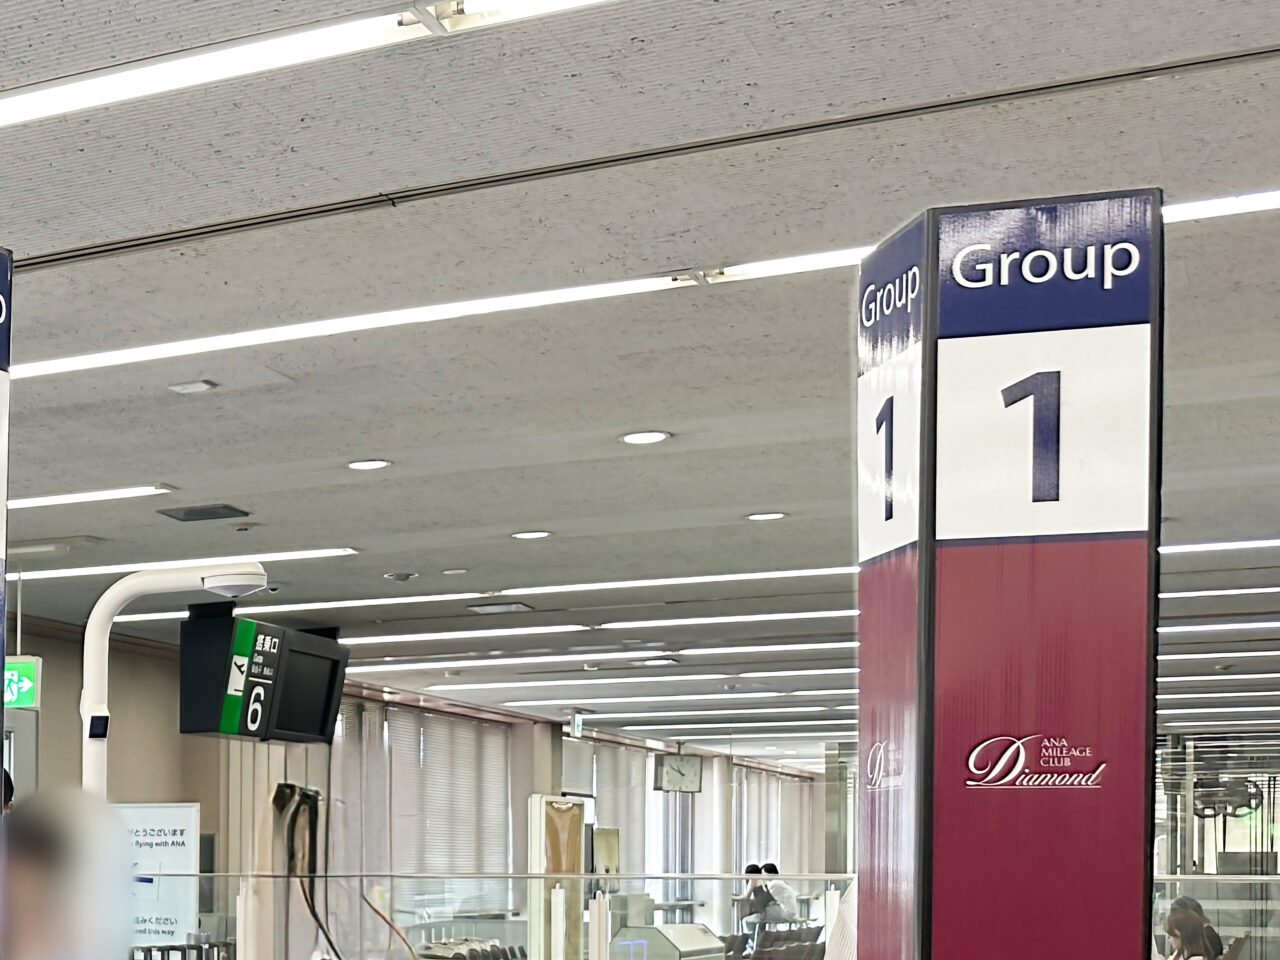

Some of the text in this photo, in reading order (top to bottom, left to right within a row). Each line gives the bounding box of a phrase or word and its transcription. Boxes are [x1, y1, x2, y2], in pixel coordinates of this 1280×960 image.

[952, 241, 1140, 289] Group
[861, 265, 920, 328] Group
[875, 395, 894, 522] 1
[1001, 370, 1061, 503] 1
[247, 685, 265, 731] 6
[966, 734, 1107, 786] Diamond
[1039, 757, 1072, 767] CLUB
[1040, 738, 1068, 748] ANA
[1040, 747, 1093, 757] MILEAGE
[128, 828, 186, 837] とうございます
